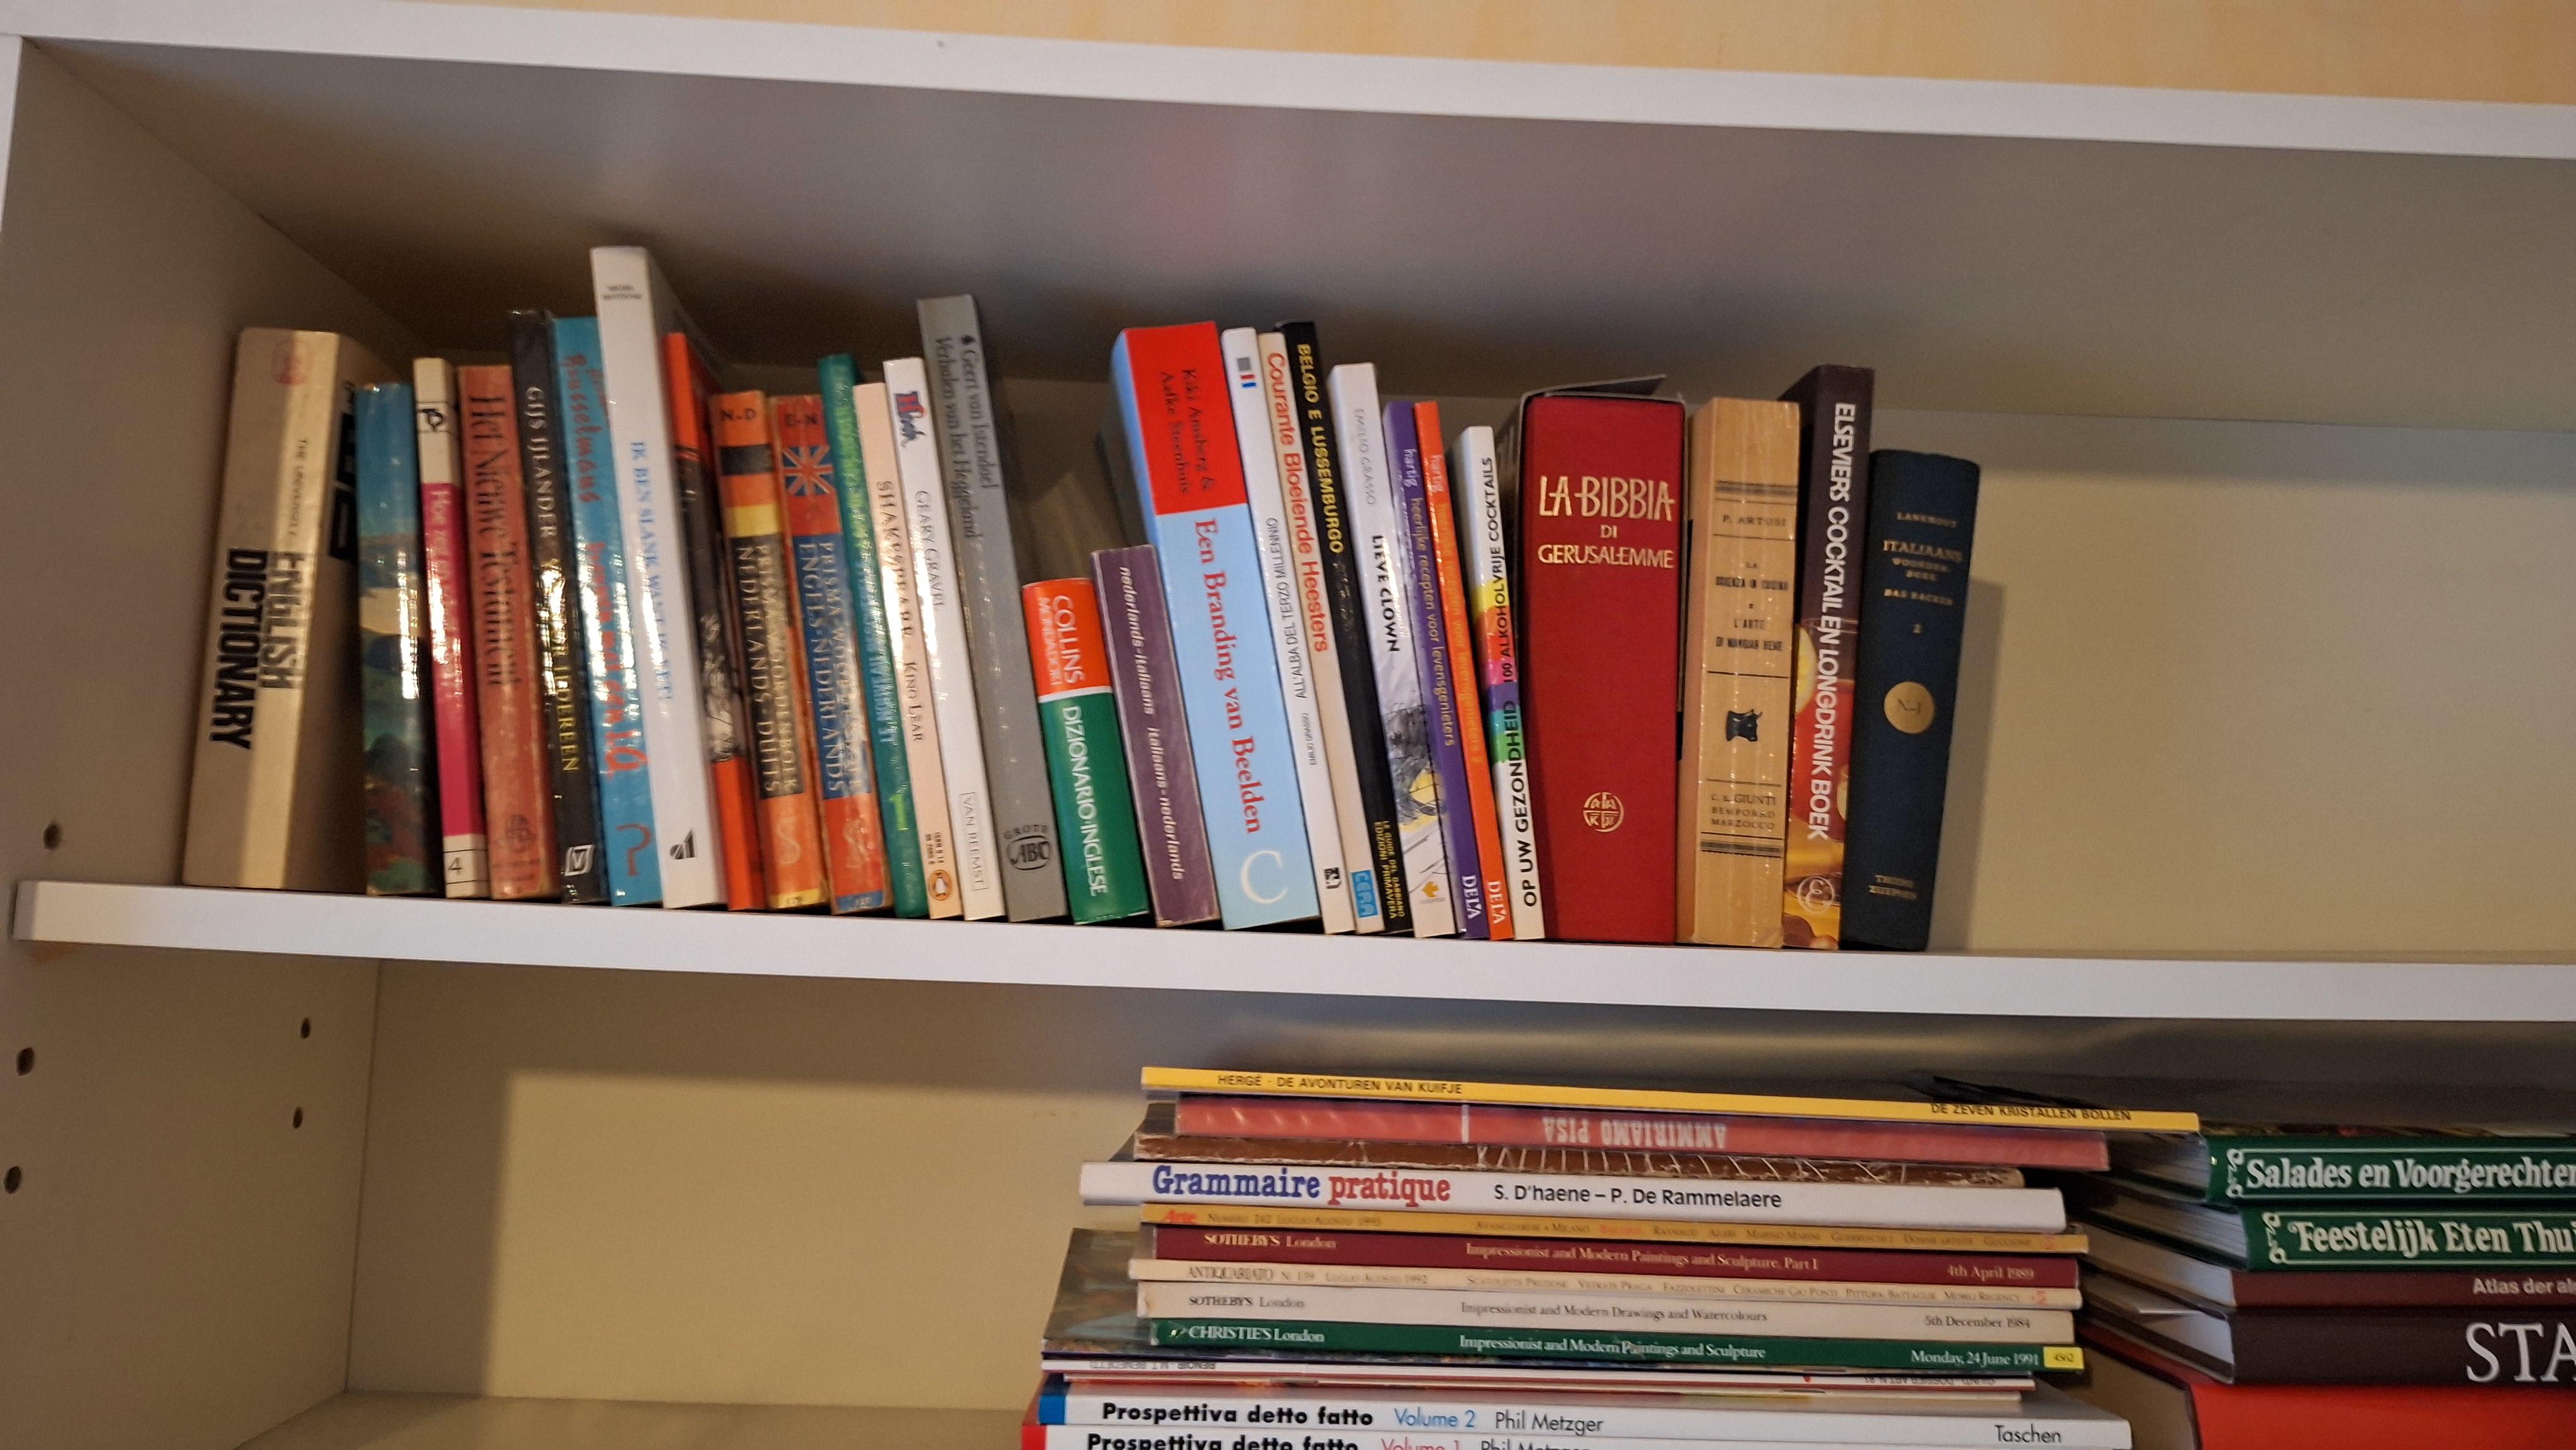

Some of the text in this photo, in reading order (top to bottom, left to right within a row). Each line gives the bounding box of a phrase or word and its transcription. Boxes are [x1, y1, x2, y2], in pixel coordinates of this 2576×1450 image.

[1296, 344, 1320, 403] BELGIO
[525, 386, 547, 429] GIJS
[959, 349, 1001, 489] Geert van Istendael
[1160, 371, 1191, 494] Aafke Steenhuis
[1181, 368, 1215, 490] Kiki &
[1307, 410, 1322, 420] E
[935, 336, 982, 539] Verhalen van het Heggeland
[527, 438, 558, 537] IJLANDER
[630, 440, 662, 566] IK BEN SLANK
[1267, 352, 1330, 653] Courante Bloeiende Heesters
[1310, 426, 1344, 554] LUSSEMBURGO
[1360, 457, 1376, 505] GRASSO
[470, 395, 523, 686] Het Nieuwe Testament
[1599, 524, 1618, 539] DI
[1738, 515, 1787, 527] ARTUSI
[914, 490, 946, 608] GEARY GRAVEL
[1537, 544, 1674, 569] GERUSALEMME
[1883, 539, 1964, 563] ITALIAANS
[820, 541, 844, 616] PRISMA
[1371, 535, 1400, 652] LIEVE CLOWN
[1403, 448, 1456, 746] hartig heerlijke recepten voor levensgenieters
[261, 551, 315, 690] ENGLISH
[1265, 517, 1308, 699] ALL'ALBA DEL TERZO MILLENNIO
[1806, 402, 1856, 841] ELSEVIERS COCKTAIL EN LONGDRINK BOEK
[208, 548, 266, 750] DICTIONARY
[1051, 594, 1085, 684] COLLINS
[903, 662, 926, 741] KING LEAR
[1195, 517, 1265, 835] Een Branding van Beelden
[1481, 457, 1537, 907] OP UW GEZONDHEID 100 ALKOHOLVRIJE COCKTAILS
[556, 666, 580, 772] IEDEREEN
[765, 632, 799, 789] WOORDENBOEK
[758, 720, 780, 793] DUITS
[962, 796, 975, 826] VAN
[1710, 818, 1775, 830] MARZOCCO
[1711, 806, 1775, 819] BEMPORAD
[1734, 793, 1777, 806] GIUNTI
[1373, 822, 1398, 919] EDIZIONI PRIMAVERA
[1384, 832, 1398, 873] GUIDE DEL
[1355, 872, 1375, 915] CERA
[1276, 1076, 1462, 1094] DE AVONTUREN VAN KUIFJE
[1542, 1117, 1727, 1149] AMMIRIAMO PISA
[1931, 1103, 2132, 1121] DE ZEVEN KRISTALLEN BOLLEN
[1153, 1165, 1782, 1208] Grammaire pratique S. D'haene P. De Rammelaere
[2246, 1157, 2352, 1188] Salades
[2359, 1163, 2390, 1187] en
[1286, 1236, 1336, 1249] London
[1466, 1243, 1549, 1259] Impressionist
[1553, 1247, 1576, 1259] and
[1579, 1248, 1629, 1261] Modern
[1631, 1250, 1690, 1267] Paintings
[1691, 1253, 1714, 1266] and
[1785, 1257, 1811, 1269] Part
[1947, 1266, 1967, 1277] 4th
[1972, 1266, 2003, 1280] April
[2287, 1220, 2438, 1259] Feestelijk
[2440, 1221, 2511, 1252] Eten
[1189, 1267, 1273, 1279] ANTIQUARIATO
[2472, 1277, 2554, 1294] Atlas der
[1259, 1297, 1305, 1307] London
[1461, 1302, 1536, 1317] Impressionist
[1540, 1304, 1560, 1315] and
[1563, 1305, 1609, 1317] Modern
[1612, 1306, 1665, 1321] Drawings
[1668, 1309, 1689, 1320] and
[1692, 1309, 1768, 1321] Watercolours
[1925, 1315, 1942, 1327] 5th
[1945, 1315, 2001, 1329] December
[1273, 1329, 1325, 1343] London
[1460, 1334, 1541, 1351] Impressionist
[1543, 1336, 1568, 1350] and
[1569, 1338, 1619, 1353] Modern
[1622, 1341, 1679, 1358] Paintings
[1681, 1343, 1703, 1356] and
[1706, 1344, 1766, 1360] Sculpture
[1911, 1350, 1964, 1365] Monday,
[1967, 1353, 1981, 1365] 24
[1981, 1353, 2010, 1367] June
[2013, 1353, 2039, 1366] 1991
[1088, 1433, 1358, 1450] Prospettiva detto fatto
[1102, 1402, 2061, 1443] Prospettiva detto fatto Volume 2 Phil Metzger Taschen
